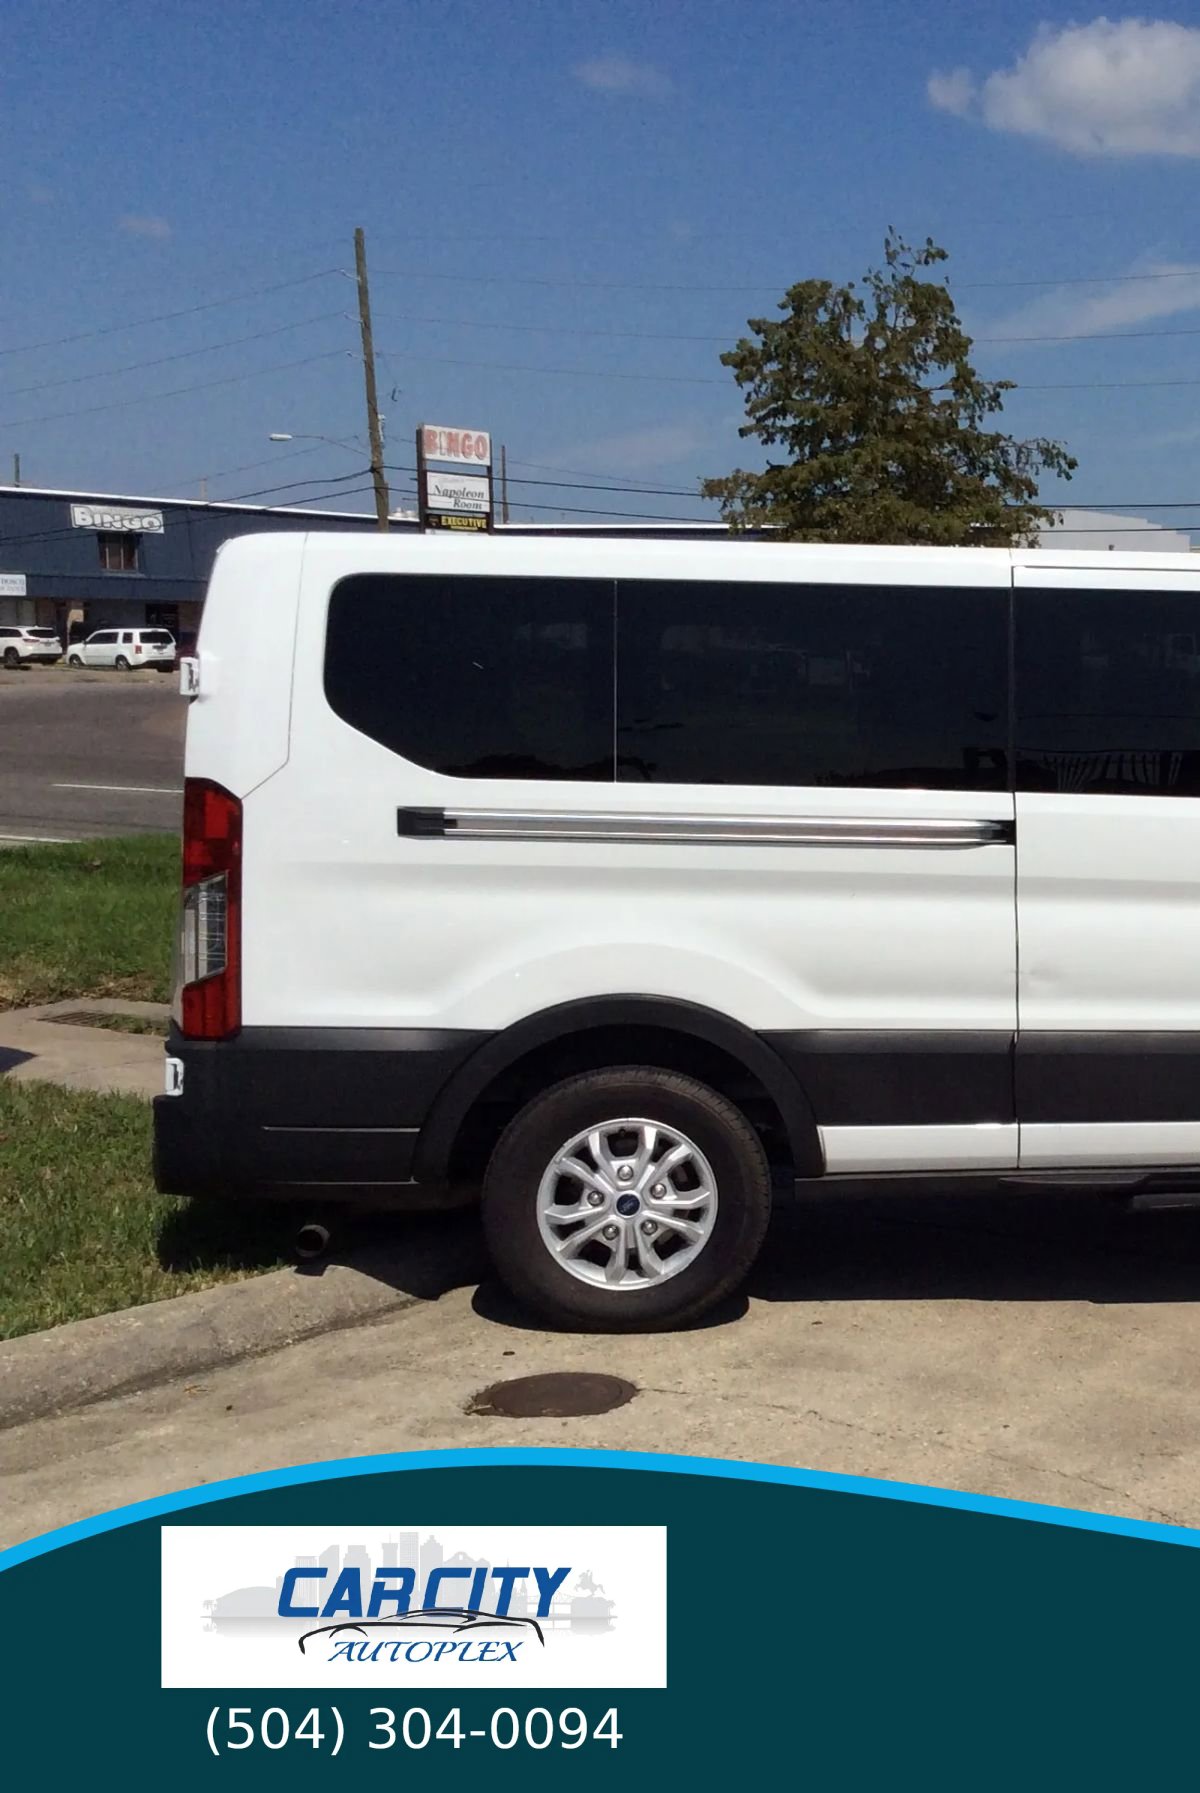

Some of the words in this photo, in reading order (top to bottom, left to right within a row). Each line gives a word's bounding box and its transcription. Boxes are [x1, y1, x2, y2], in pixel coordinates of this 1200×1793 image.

[424, 429, 488, 460] BINGO
[433, 485, 485, 499] Napoleon
[453, 499, 483, 510] Room
[72, 505, 162, 531] BINGO
[441, 515, 487, 528] EXECUTIVE
